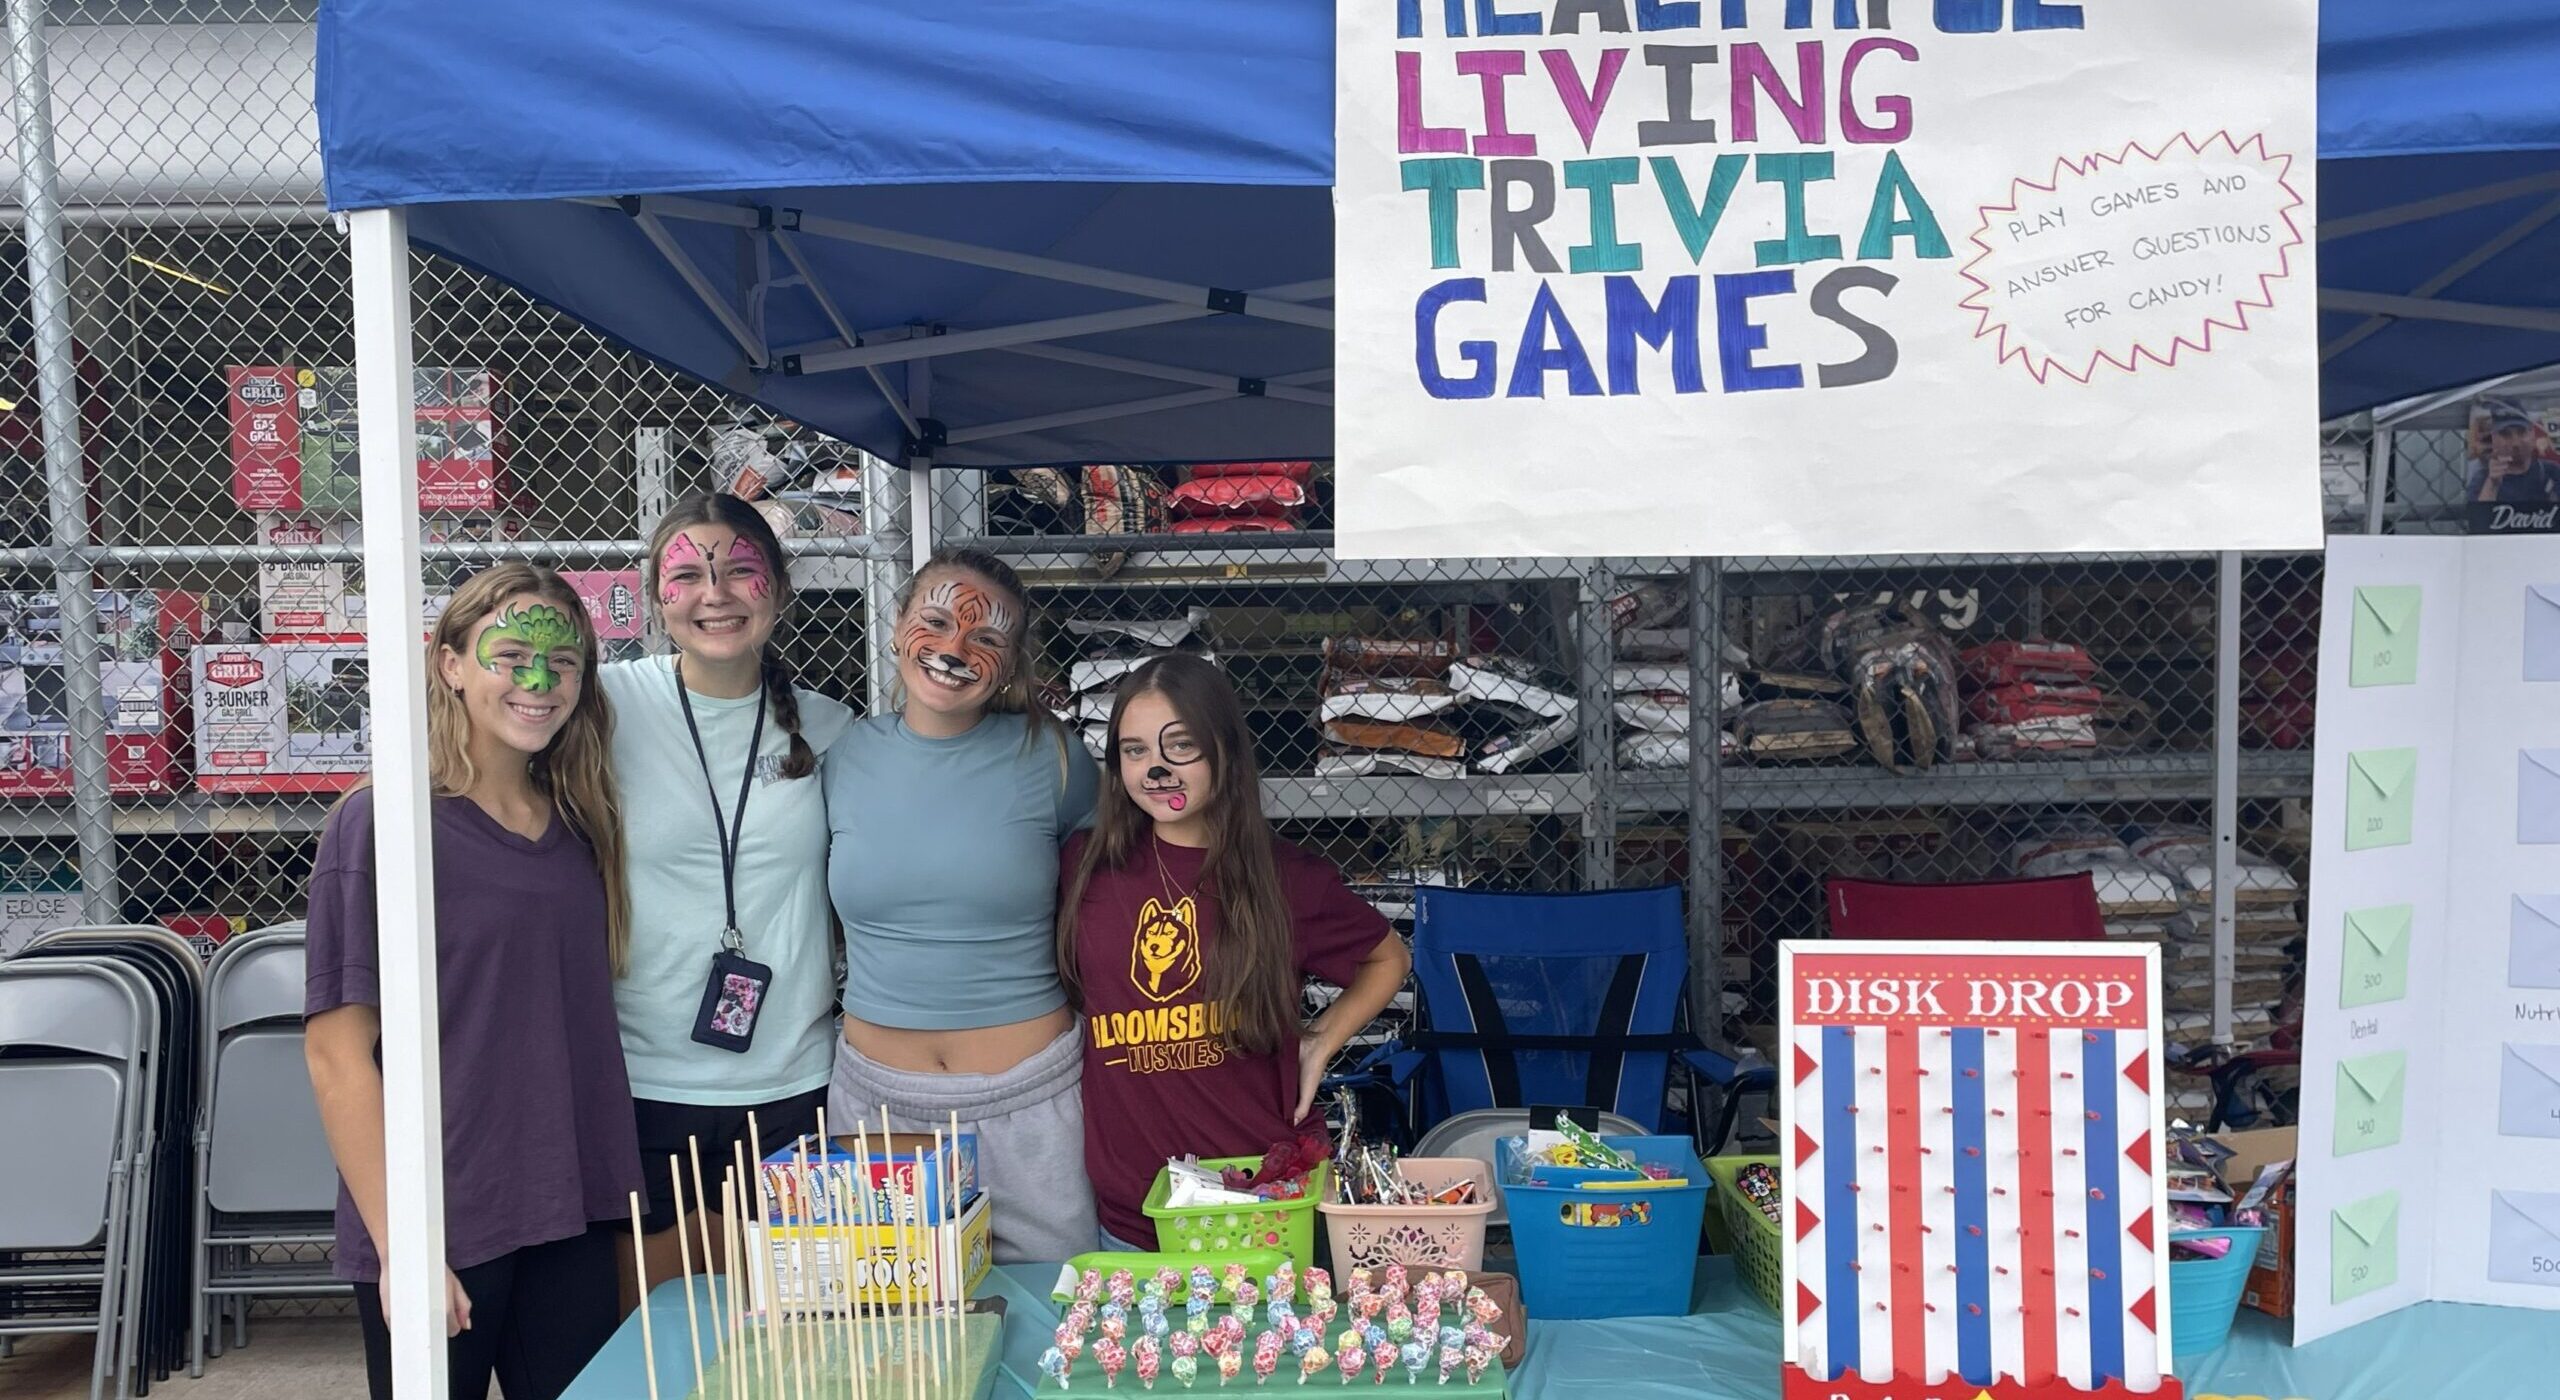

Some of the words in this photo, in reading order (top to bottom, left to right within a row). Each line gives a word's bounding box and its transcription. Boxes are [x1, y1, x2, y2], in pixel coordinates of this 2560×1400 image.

[1395, 37, 1919, 156] LIVING
[1399, 149, 1953, 273] TRIVIA
[2008, 207, 2066, 242] PLAY
[2091, 182, 2179, 217] GAMES
[2203, 174, 2246, 195] AND
[2008, 250, 2115, 298] ANSWER
[2132, 224, 2272, 260] QUESTIONS
[2064, 301, 2111, 329] FOR
[2128, 274, 2223, 310] CANDY!
[1415, 266, 1900, 399] GAMES
[241, 386, 284, 399] GRILL
[2490, 504, 2559, 530] David
[211, 664, 259, 679] GRILL
[204, 690, 269, 708] 3-BURNER
[6, 899, 66, 915] EDGE
[1805, 978, 1948, 1016] DISK
[1966, 979, 2134, 1018] DROP
